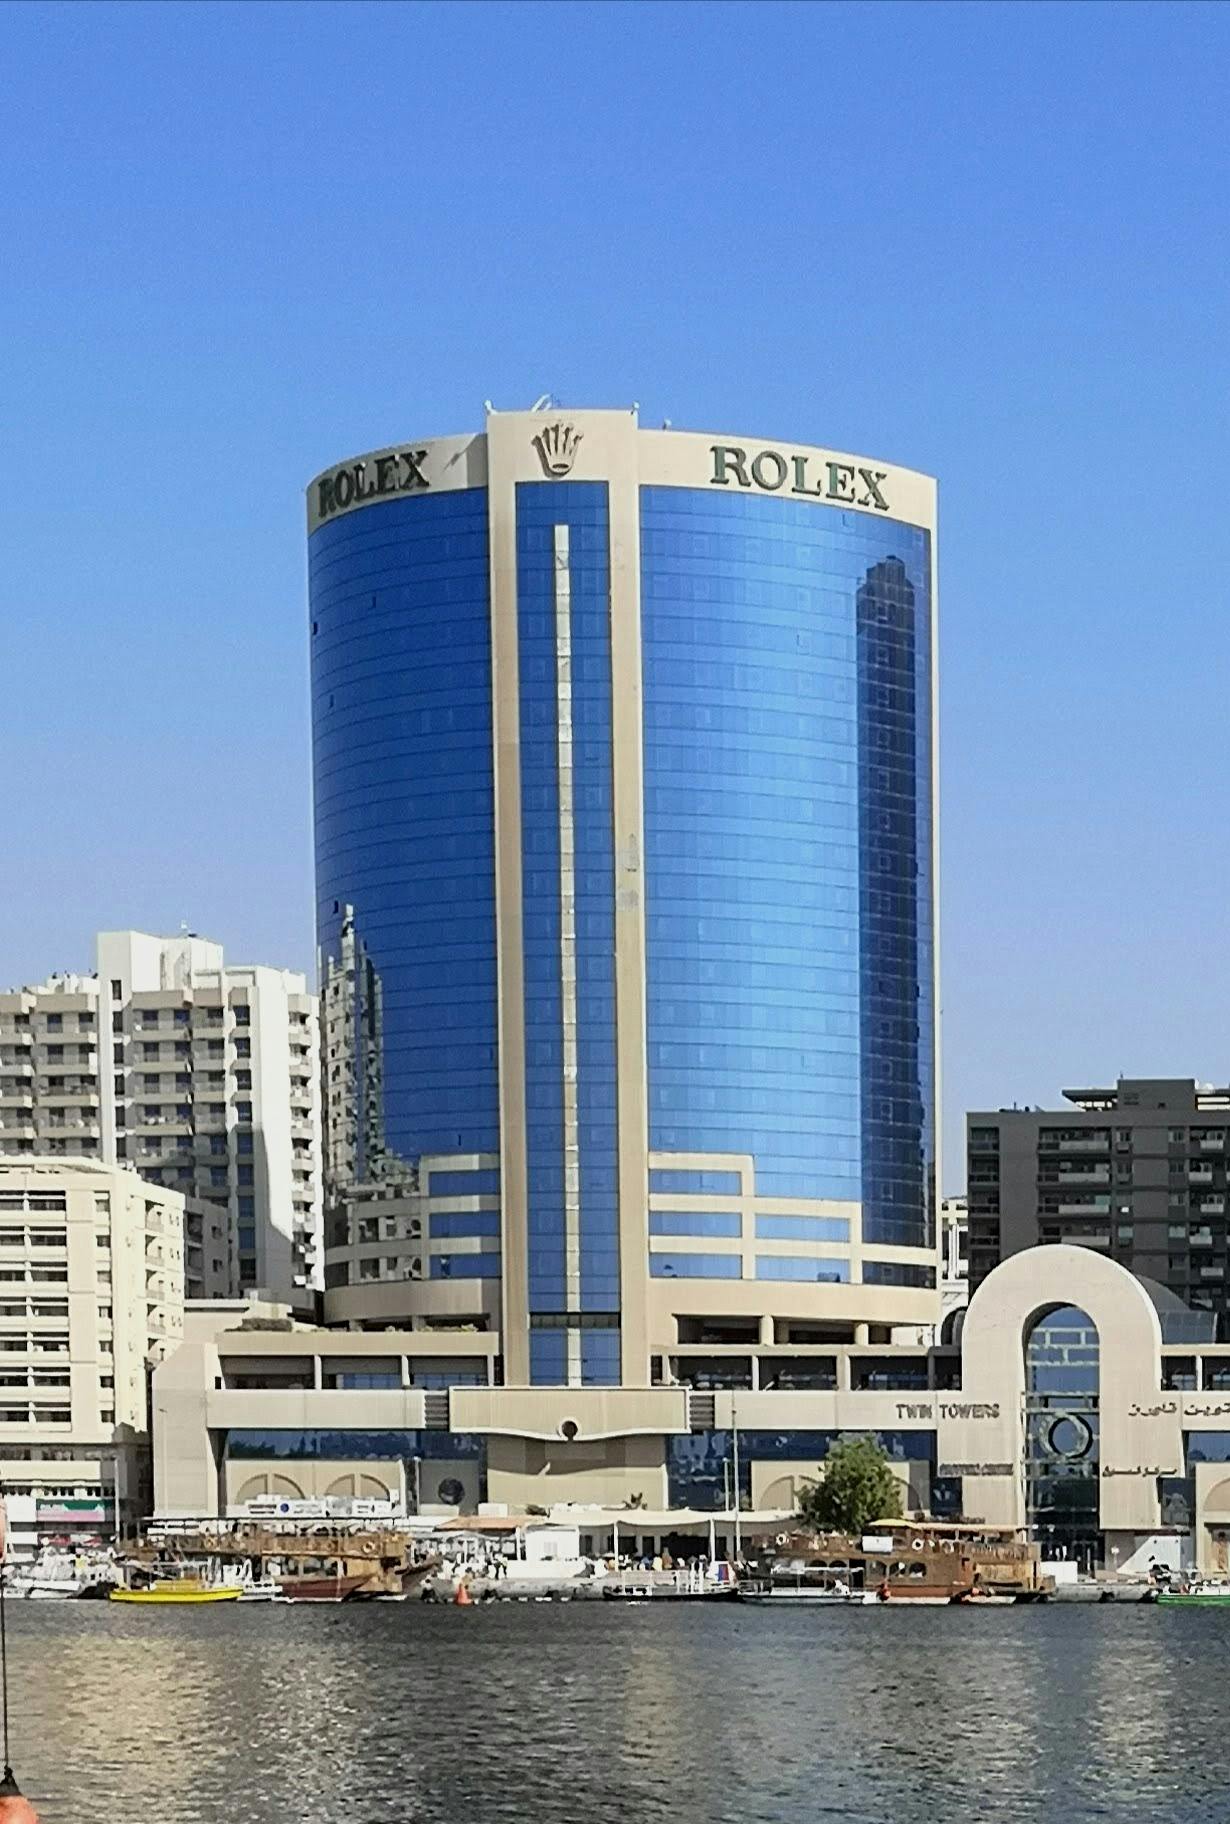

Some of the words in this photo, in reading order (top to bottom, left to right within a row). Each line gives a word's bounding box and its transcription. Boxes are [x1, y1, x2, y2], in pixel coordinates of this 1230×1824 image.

[317, 449, 430, 517] ROLEX
[709, 445, 890, 511] ROLEX
[895, 1403, 933, 1419] TWIN
[939, 1403, 1000, 1419] TOWERS
